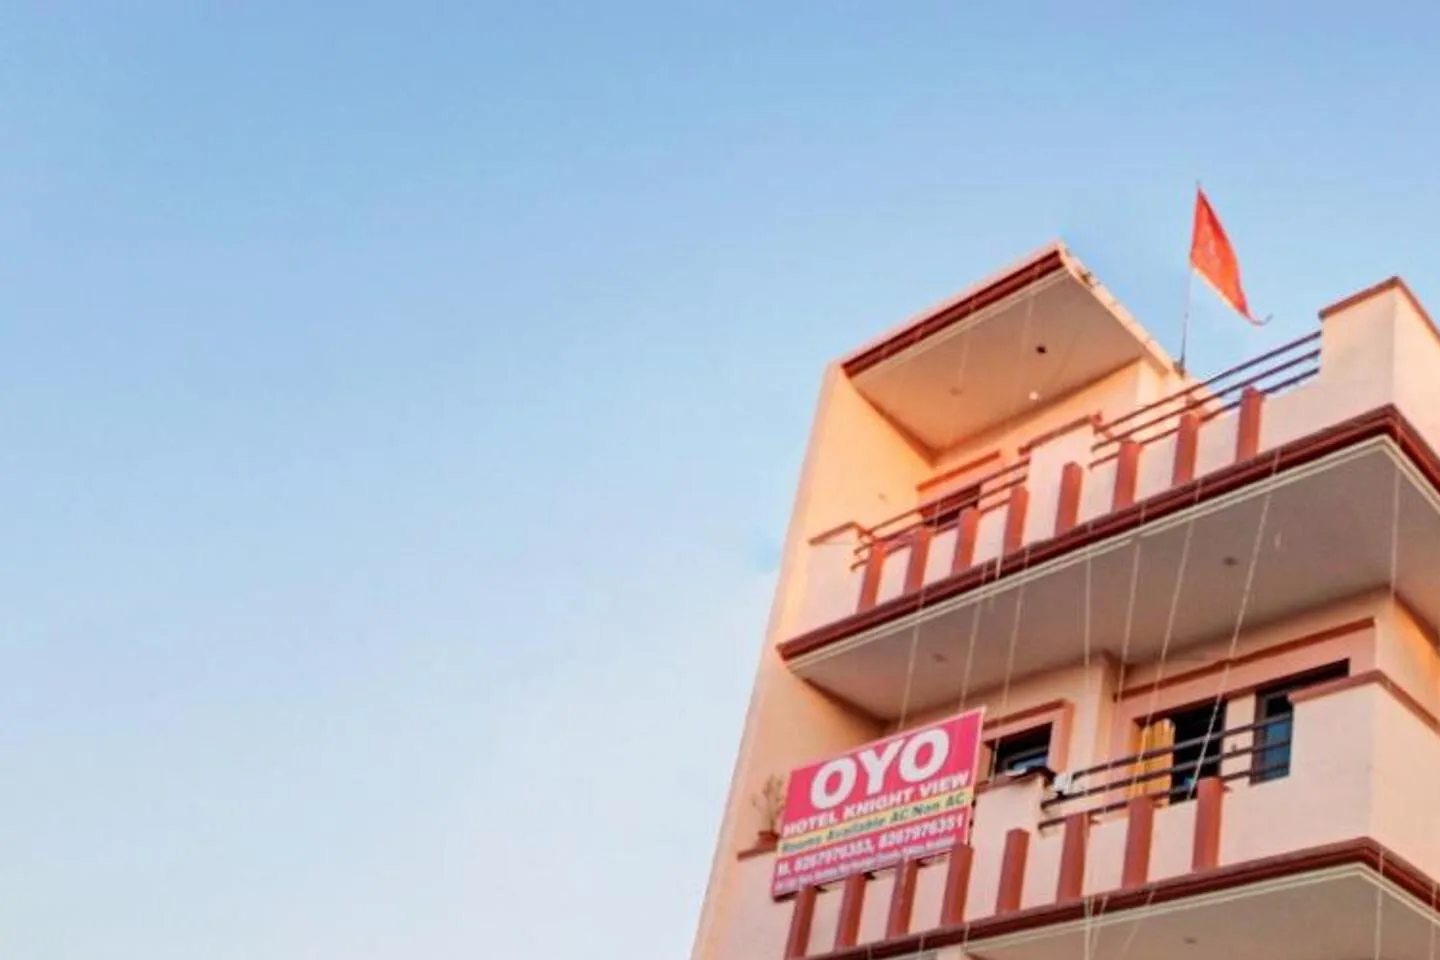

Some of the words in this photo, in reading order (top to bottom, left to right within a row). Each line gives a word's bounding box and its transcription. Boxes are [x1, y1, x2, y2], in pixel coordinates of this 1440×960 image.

[811, 729, 949, 810] OYO
[945, 793, 966, 808] AC
[783, 811, 838, 835] HOTEL
[843, 790, 913, 819] KNIGHT
[919, 771, 969, 797] VIEW
